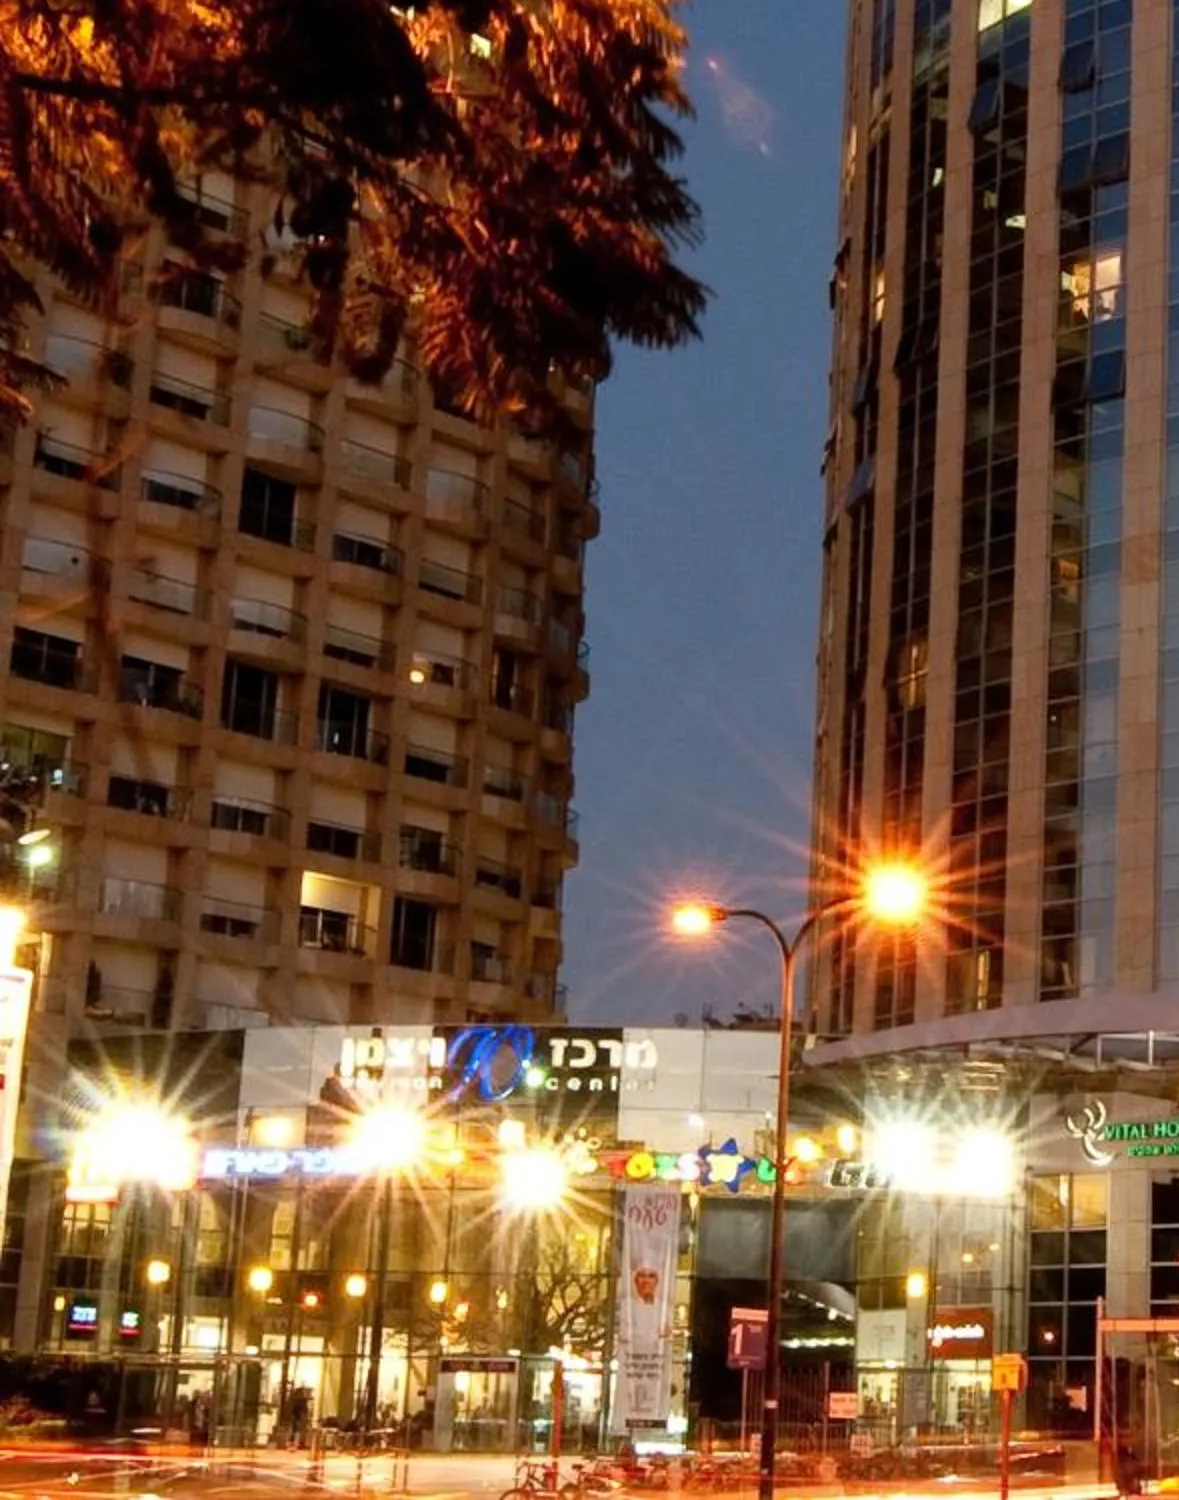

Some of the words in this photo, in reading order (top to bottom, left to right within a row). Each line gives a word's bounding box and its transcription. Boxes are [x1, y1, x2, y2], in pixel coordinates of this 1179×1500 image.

[341, 1038, 447, 1074] ויצמן
[549, 1038, 658, 1068] מרכז
[1104, 1120, 1149, 1140] VITAL
[731, 1323, 743, 1355] 1
